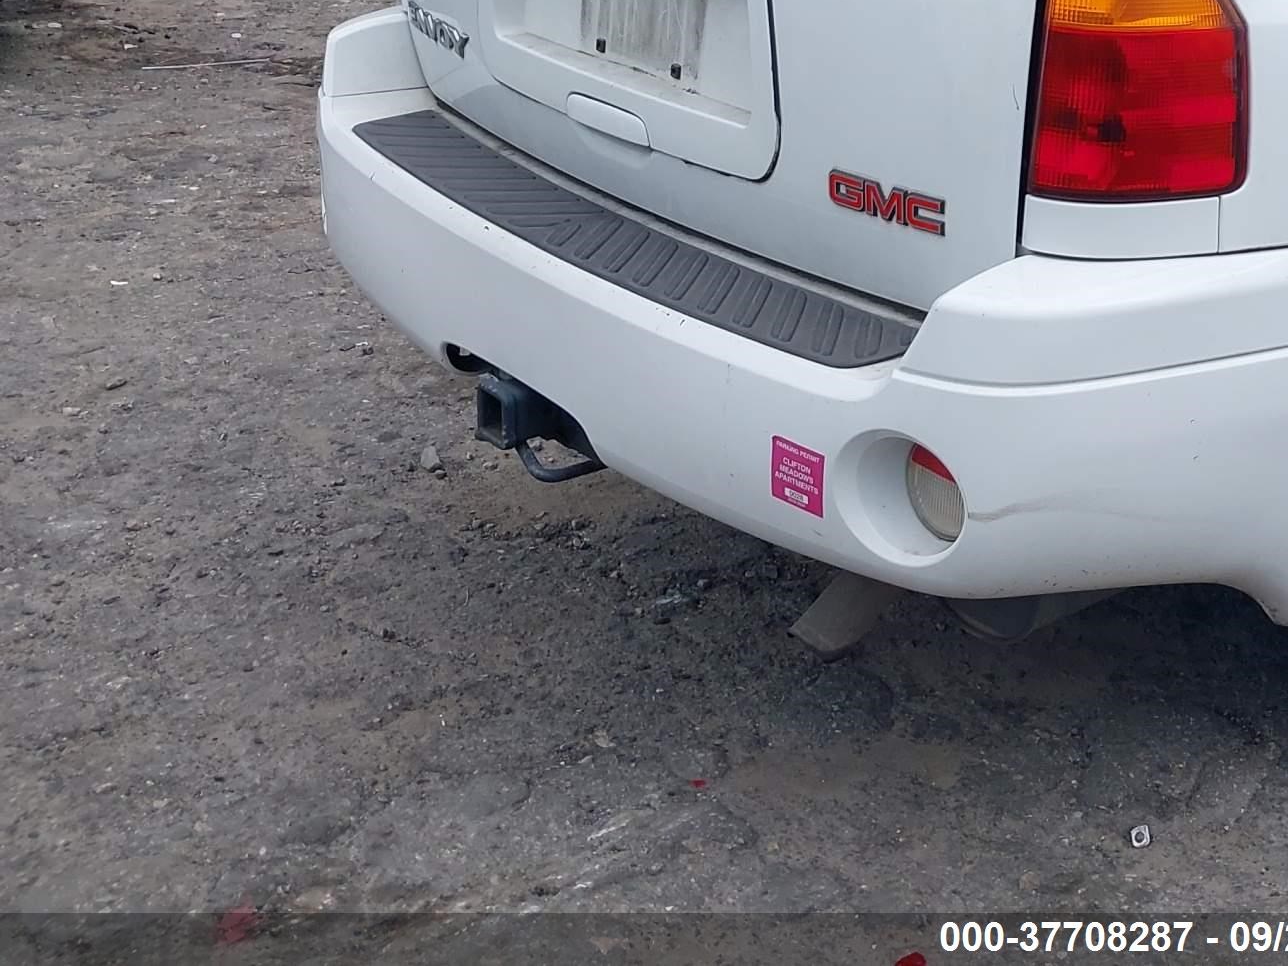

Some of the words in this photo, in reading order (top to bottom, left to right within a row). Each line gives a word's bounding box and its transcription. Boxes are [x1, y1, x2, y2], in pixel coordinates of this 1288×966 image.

[828, 168, 946, 237] GMC
[779, 464, 814, 484] MEADOWS
[782, 457, 811, 474] CLIFTON
[774, 471, 819, 495] APARTMENTS
